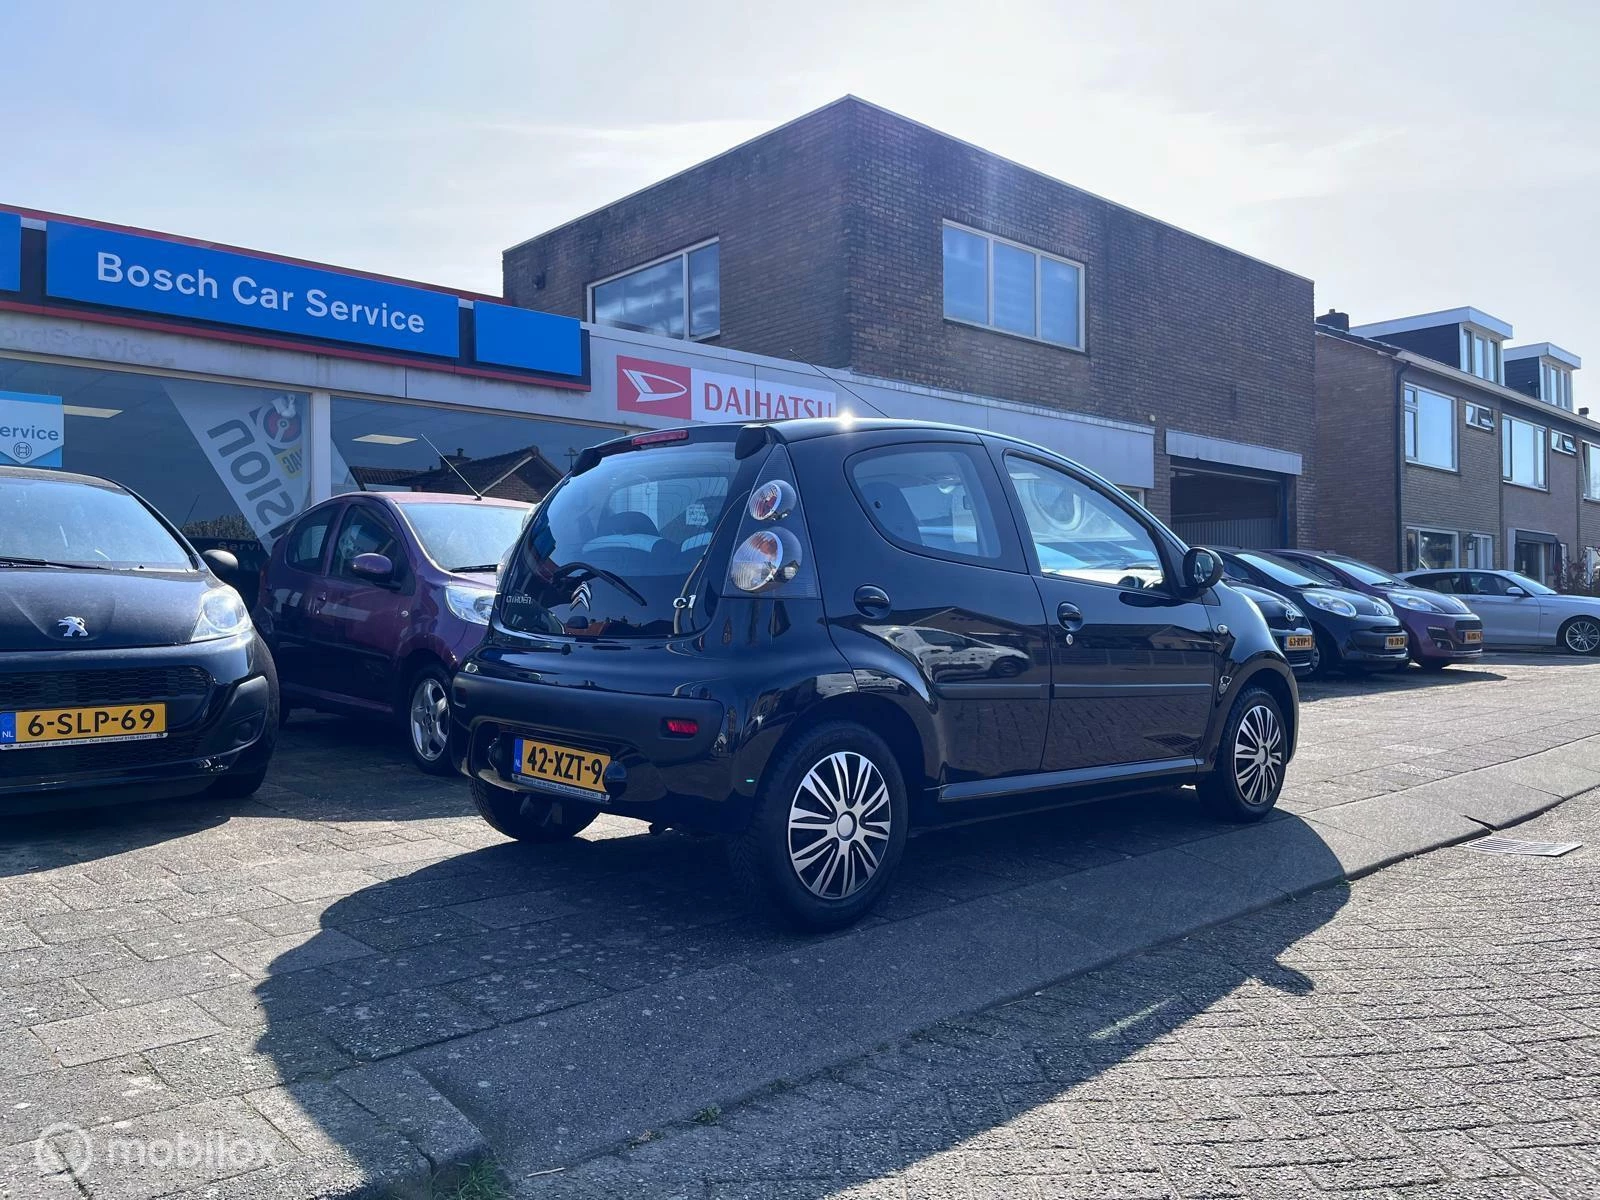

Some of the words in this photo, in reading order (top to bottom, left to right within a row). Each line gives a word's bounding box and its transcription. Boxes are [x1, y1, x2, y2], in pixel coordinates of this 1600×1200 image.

[97, 252, 218, 299] Bosch
[232, 276, 294, 311] Car
[306, 289, 424, 333] Service
[704, 382, 832, 418] DAIHATSU
[2, 731, 14, 739] NL
[28, 708, 155, 737] 6-SLP-69
[527, 746, 603, 784] 42-XZT-9
